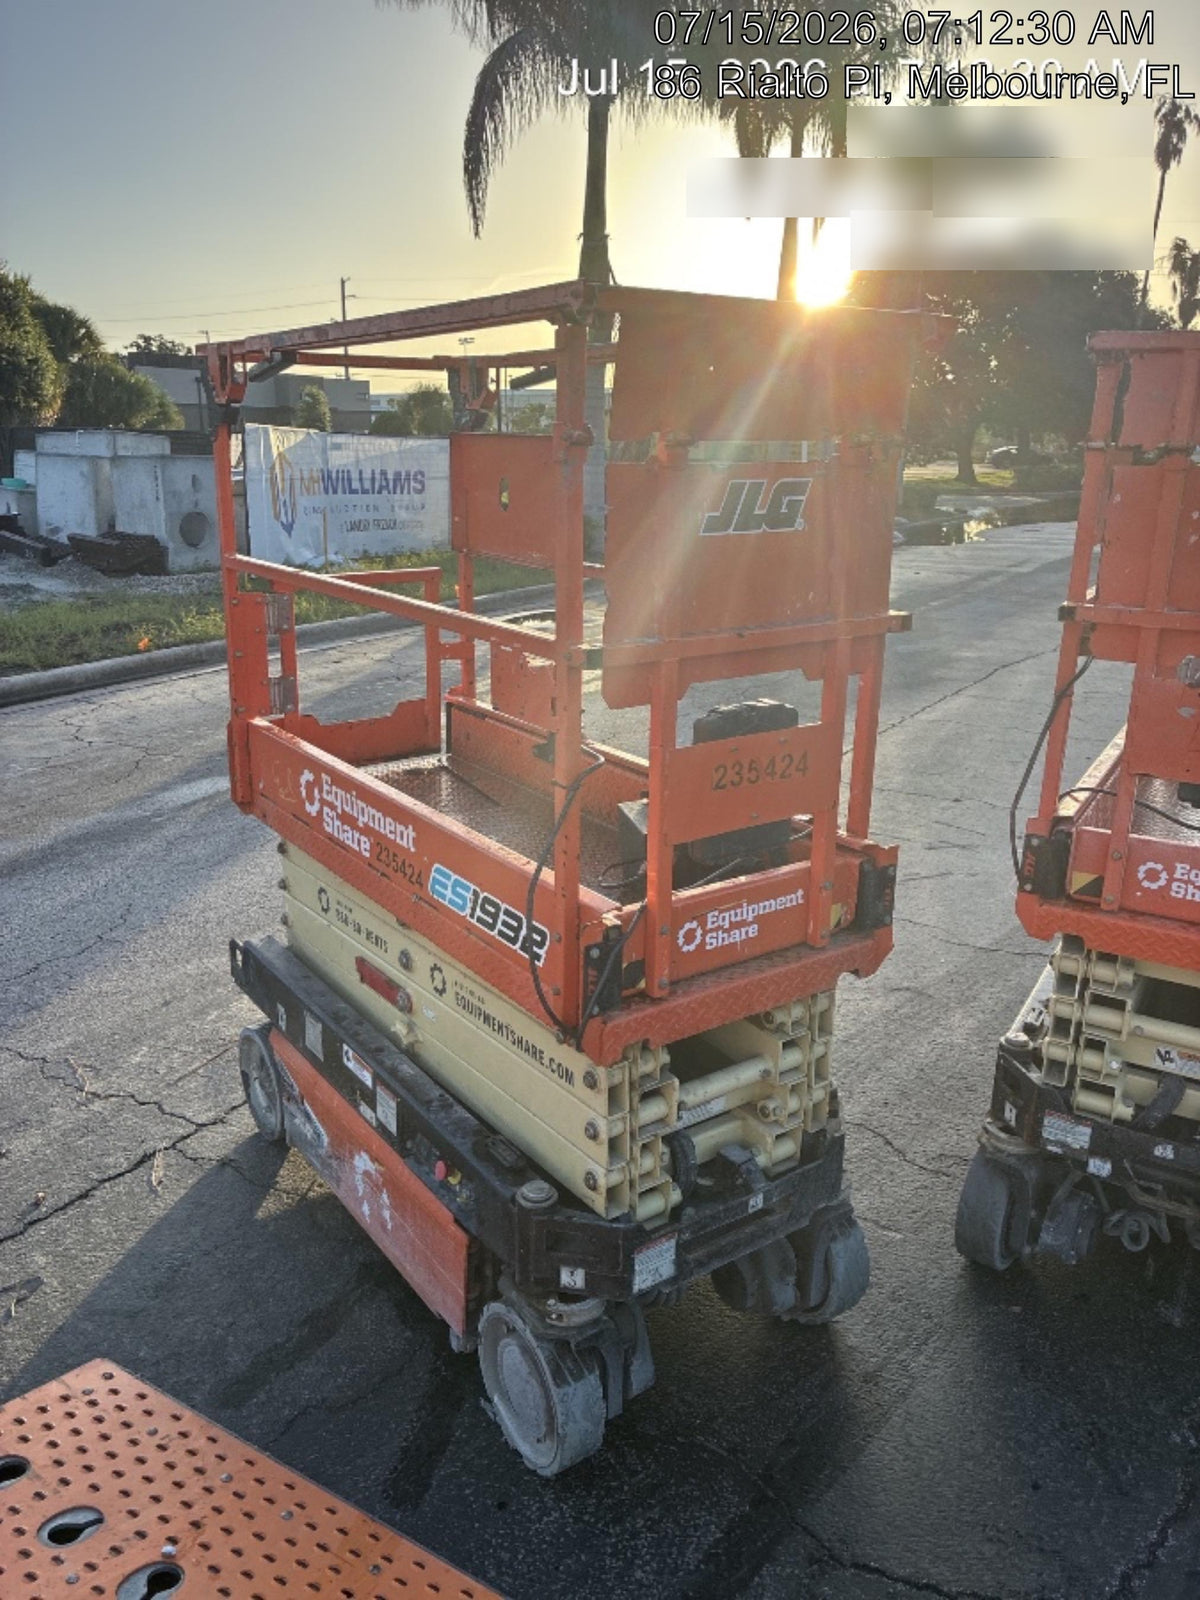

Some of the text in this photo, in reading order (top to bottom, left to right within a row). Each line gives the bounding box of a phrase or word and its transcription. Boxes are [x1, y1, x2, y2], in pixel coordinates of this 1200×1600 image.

[699, 478, 813, 536] JLG
[712, 749, 808, 791] 235424
[321, 772, 417, 852] Equipment
[322, 806, 371, 857] Share
[376, 842, 424, 888] 235424
[706, 888, 805, 930] Equipment
[705, 923, 759, 950] Share
